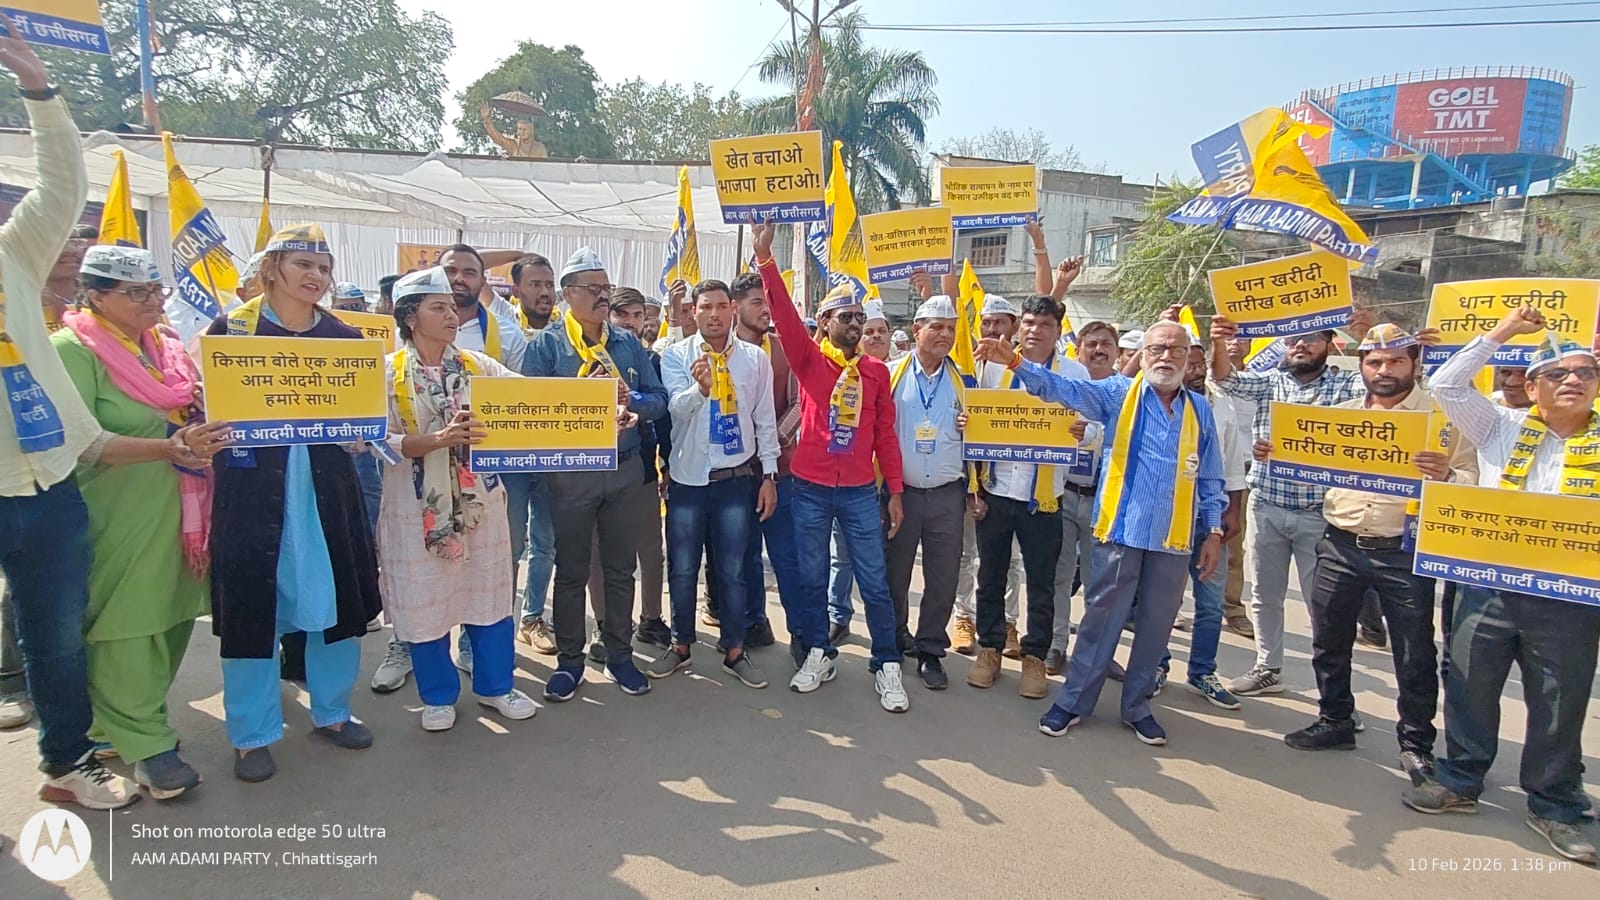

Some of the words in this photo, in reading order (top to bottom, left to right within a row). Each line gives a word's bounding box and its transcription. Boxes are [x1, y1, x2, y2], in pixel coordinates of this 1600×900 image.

[31, 22, 101, 48] छत्तीसगढ़
[1428, 86, 1499, 107] GOEL
[1434, 110, 1490, 129] TMT
[724, 148, 748, 169] खेत
[752, 142, 803, 167] बचाओ
[718, 177, 757, 194] भाजपा
[765, 168, 820, 193] हटाओ!
[947, 192, 971, 201] किसान
[780, 206, 821, 219] छत्तीसगढ़
[960, 217, 983, 226] आदमी
[985, 216, 1000, 224] पार्टी
[1262, 206, 1322, 239] AADMI
[1313, 224, 1371, 260] PARTY
[872, 271, 888, 281] आम
[889, 265, 913, 277] आदमी
[1235, 277, 1265, 293] धान
[1270, 263, 1322, 287] खरीदी
[178, 276, 213, 311] ARTY
[1225, 296, 1274, 313] तारीख
[1278, 282, 1338, 307] बढ़ाओ!
[1459, 295, 1496, 309] धान
[1501, 290, 1568, 311] खरीदी
[1246, 323, 1276, 336] आदमी
[1277, 321, 1299, 333] पार्टी
[1300, 312, 1349, 330] छत्तीसगढ़
[212, 352, 266, 368] किसान
[271, 352, 300, 368] बोले
[303, 356, 328, 370] एक
[332, 357, 377, 370] आवाज़
[1494, 349, 1522, 361] पार्टी
[241, 375, 273, 387] आम
[279, 372, 322, 388] आदमी
[327, 372, 356, 387] पार्टी
[264, 390, 300, 407] हमारे
[305, 394, 337, 405] साथ!
[480, 402, 550, 416] खेत-खलिहान
[553, 402, 569, 415] की
[571, 405, 608, 415] ललकार
[996, 404, 1029, 416] समर्पण
[1032, 407, 1045, 416] का
[251, 425, 294, 441] आदमी
[297, 423, 324, 438] पार्टी
[327, 423, 381, 438] छत्तीसगढ़
[485, 420, 520, 431] भाजपा
[523, 420, 560, 430] सरकार
[989, 419, 1010, 429] सत्ता
[1012, 418, 1051, 430] परिवर्तन
[1296, 419, 1331, 434] धान
[1335, 420, 1398, 442] खरीदी
[967, 448, 984, 457] आम
[986, 447, 1012, 458] आदमी
[1014, 448, 1033, 458] पार्टी
[1034, 449, 1072, 463] छत्तीसगढ़
[1281, 437, 1337, 457] तारीख
[1341, 445, 1410, 465] बढ़ाओ!
[1569, 443, 1599, 456] पार्टी
[476, 457, 500, 467] आम
[503, 454, 537, 467] आदमी
[540, 453, 563, 466] पार्टी
[564, 452, 611, 466] छत्तीसगढ़
[1273, 465, 1294, 477] आम
[1297, 468, 1331, 483] आदमी
[1333, 474, 1360, 487] पार्टी
[1360, 478, 1416, 496] छत्तीसगढ़
[1565, 477, 1596, 488] आम
[1438, 504, 1457, 520] जो
[1460, 509, 1500, 526] कराए
[1425, 520, 1467, 536] उनका
[1470, 528, 1521, 544] कराओ
[1524, 534, 1558, 549] सत्ता
[1562, 540, 1600, 554] समर्प
[1420, 560, 1449, 574] आम
[1452, 565, 1497, 582] आदमी
[1501, 572, 1535, 588] पार्टी
